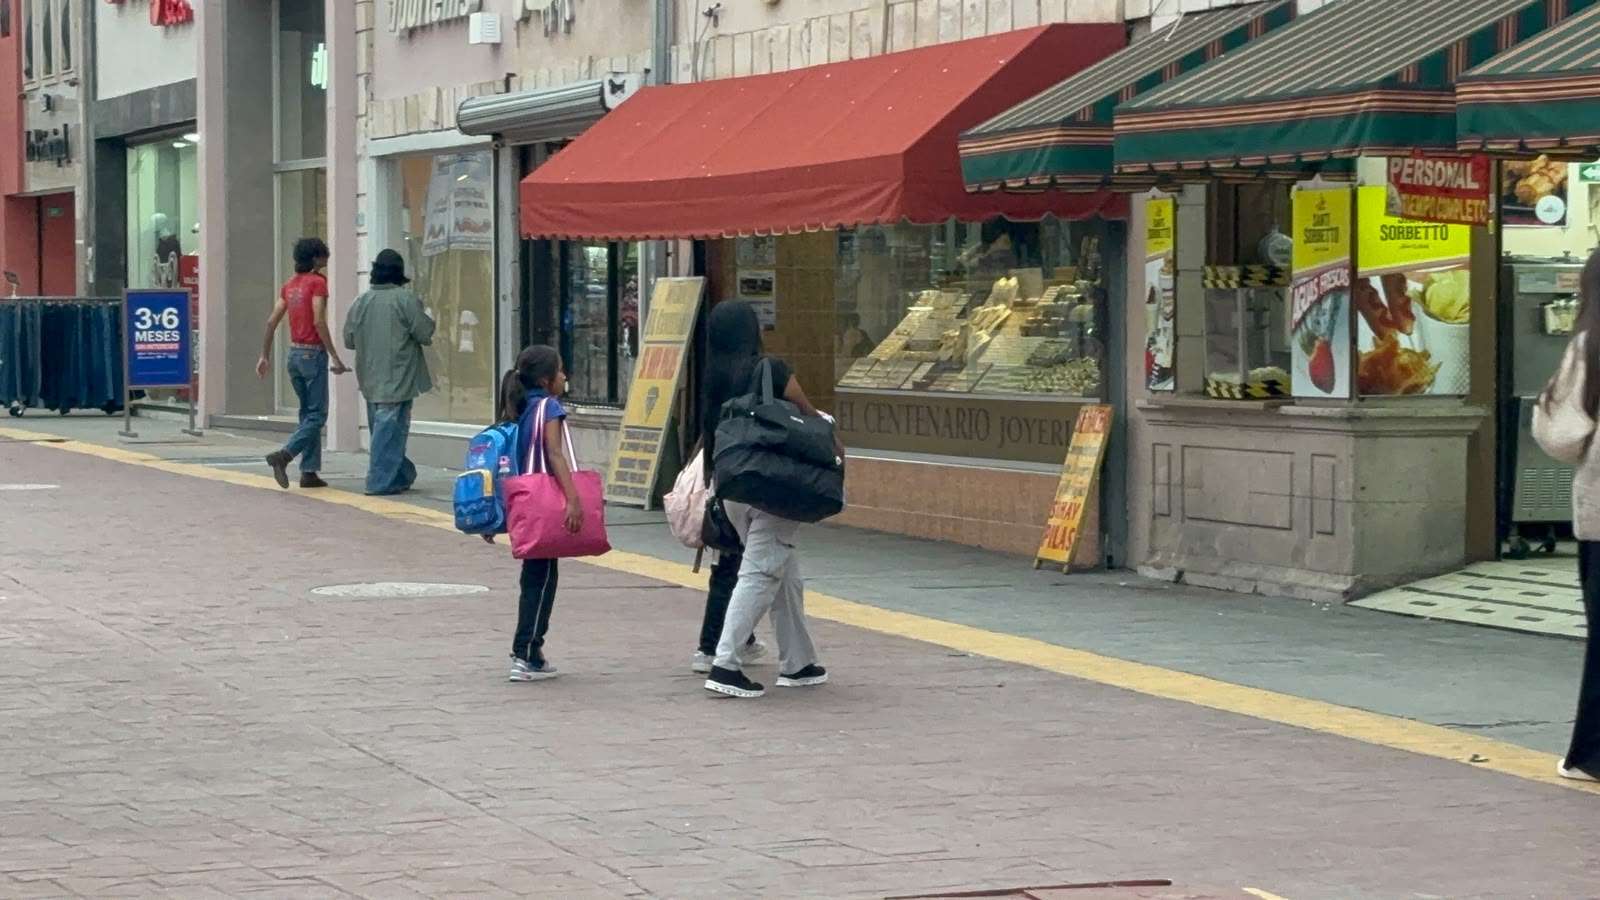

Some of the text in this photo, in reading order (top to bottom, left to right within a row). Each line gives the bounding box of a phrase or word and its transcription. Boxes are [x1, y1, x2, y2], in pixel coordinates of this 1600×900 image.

[1389, 157, 1480, 190] PERSONAL
[1437, 196, 1488, 222] COMPLETO
[1303, 226, 1340, 244] SORBETTO
[1380, 223, 1449, 241] SORBETTO
[134, 330, 180, 342] MESES
[838, 400, 857, 432] EL
[863, 402, 991, 441] CENTENARIO
[997, 415, 1072, 448] JOYERI
